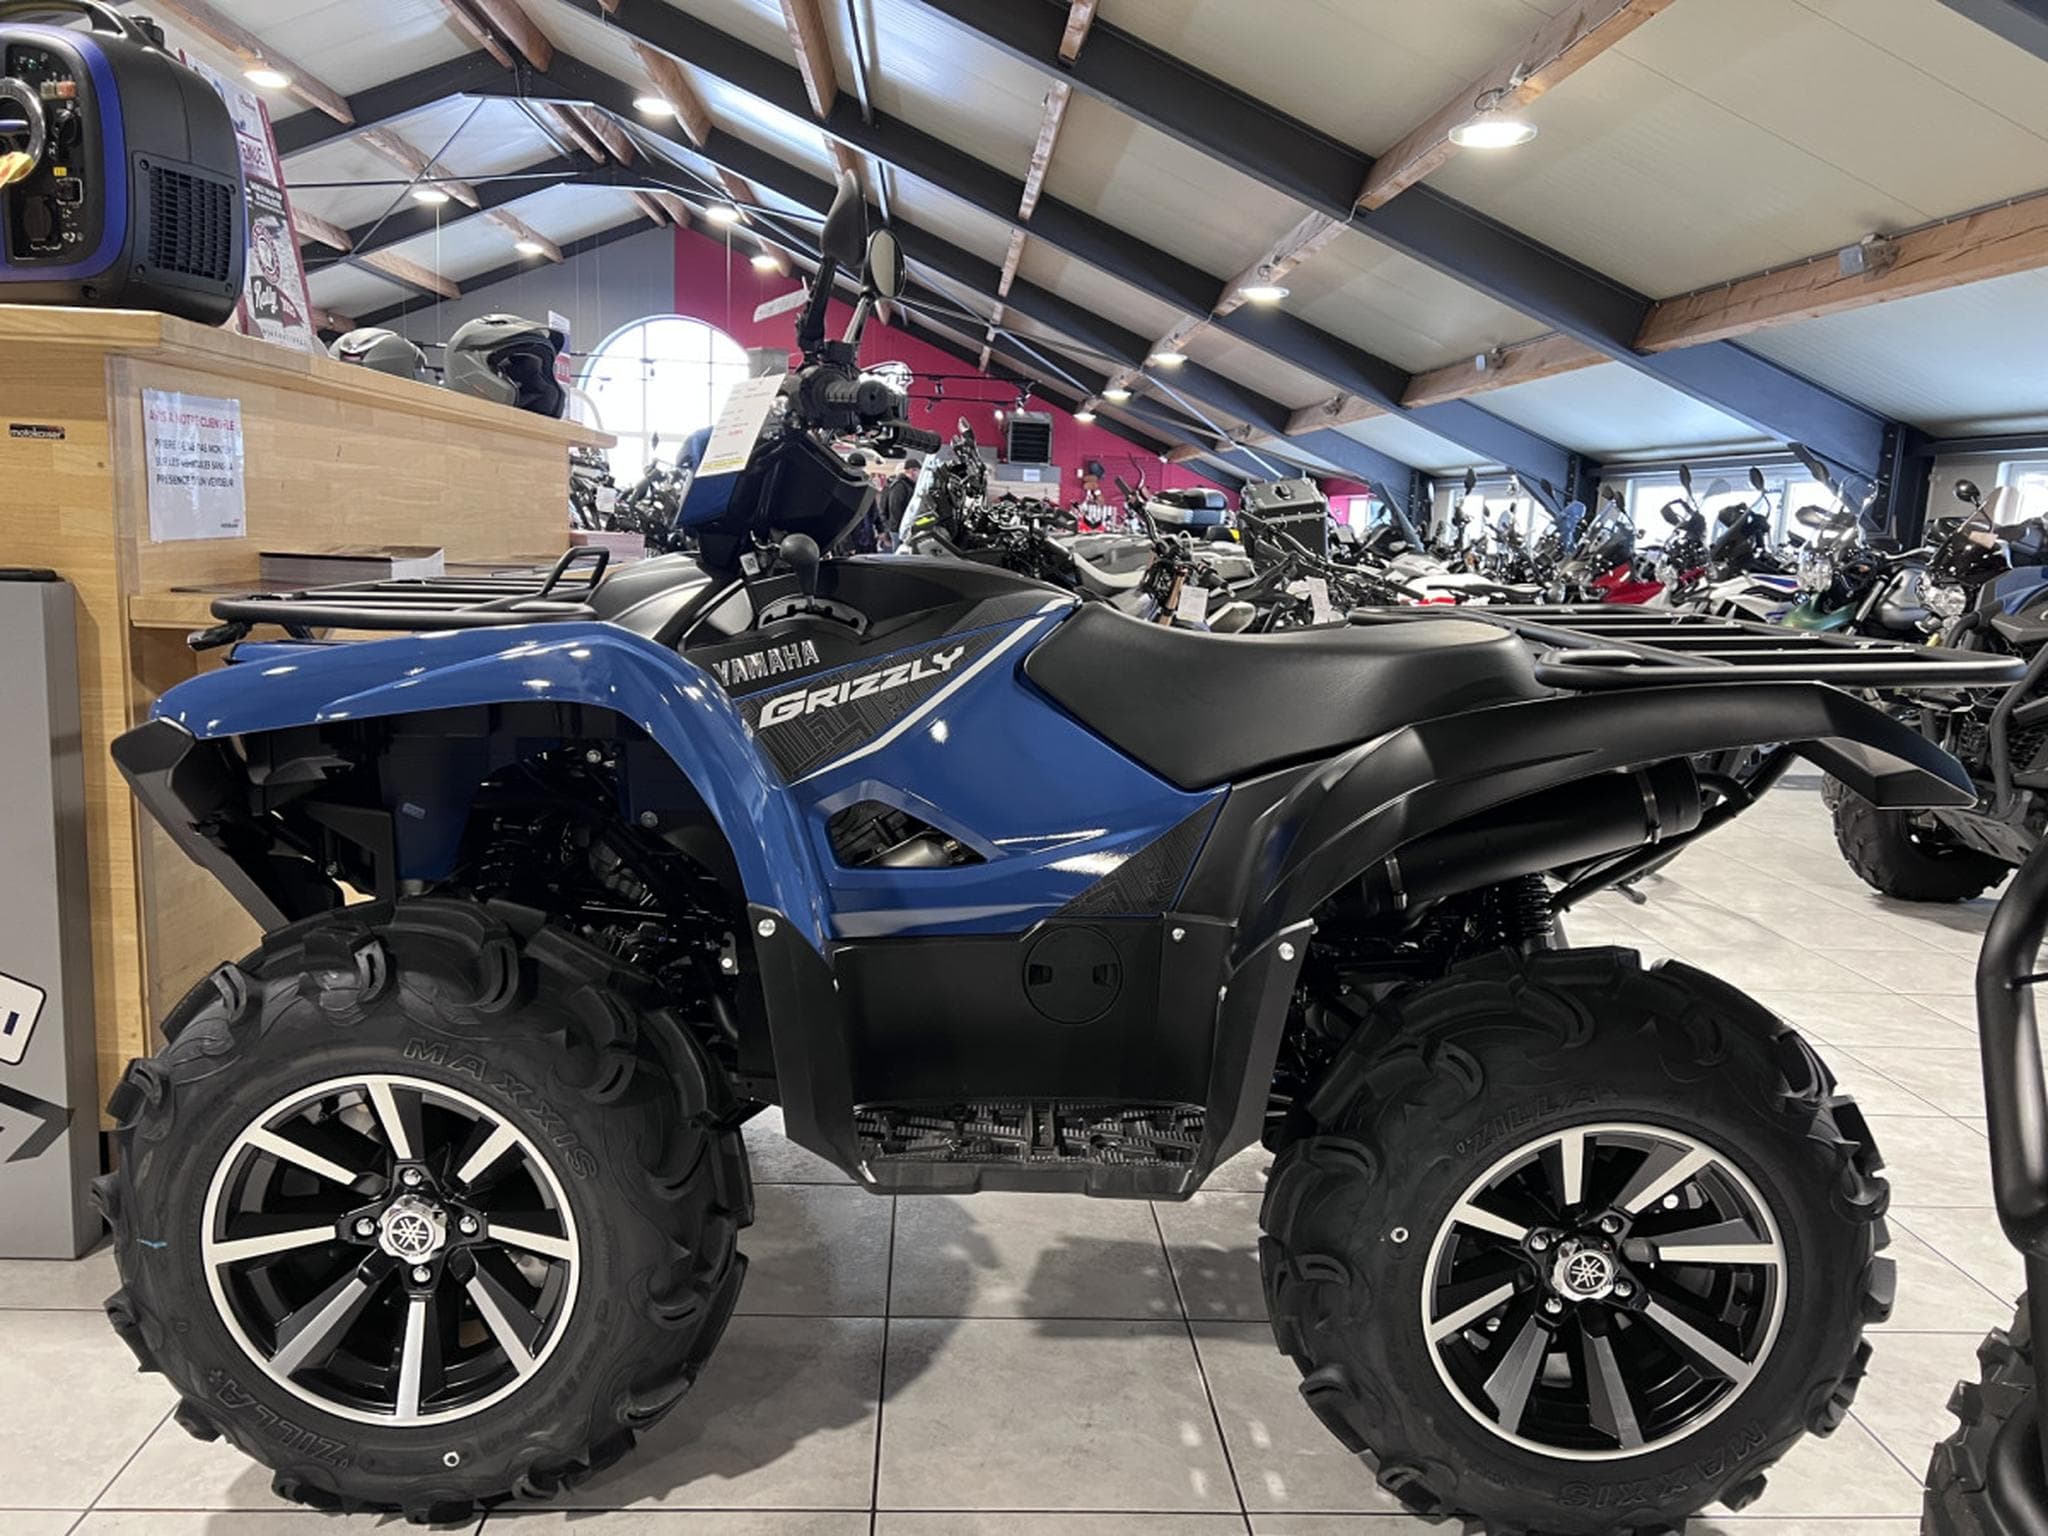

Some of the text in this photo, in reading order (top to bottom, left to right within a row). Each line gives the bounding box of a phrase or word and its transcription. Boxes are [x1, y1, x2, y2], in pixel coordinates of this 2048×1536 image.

[712, 639, 821, 688] YAMAHA
[758, 645, 966, 730] GRIZZLY
[403, 1037, 598, 1180] MAXXIS
[1558, 1421, 1767, 1510] MAXXIS
